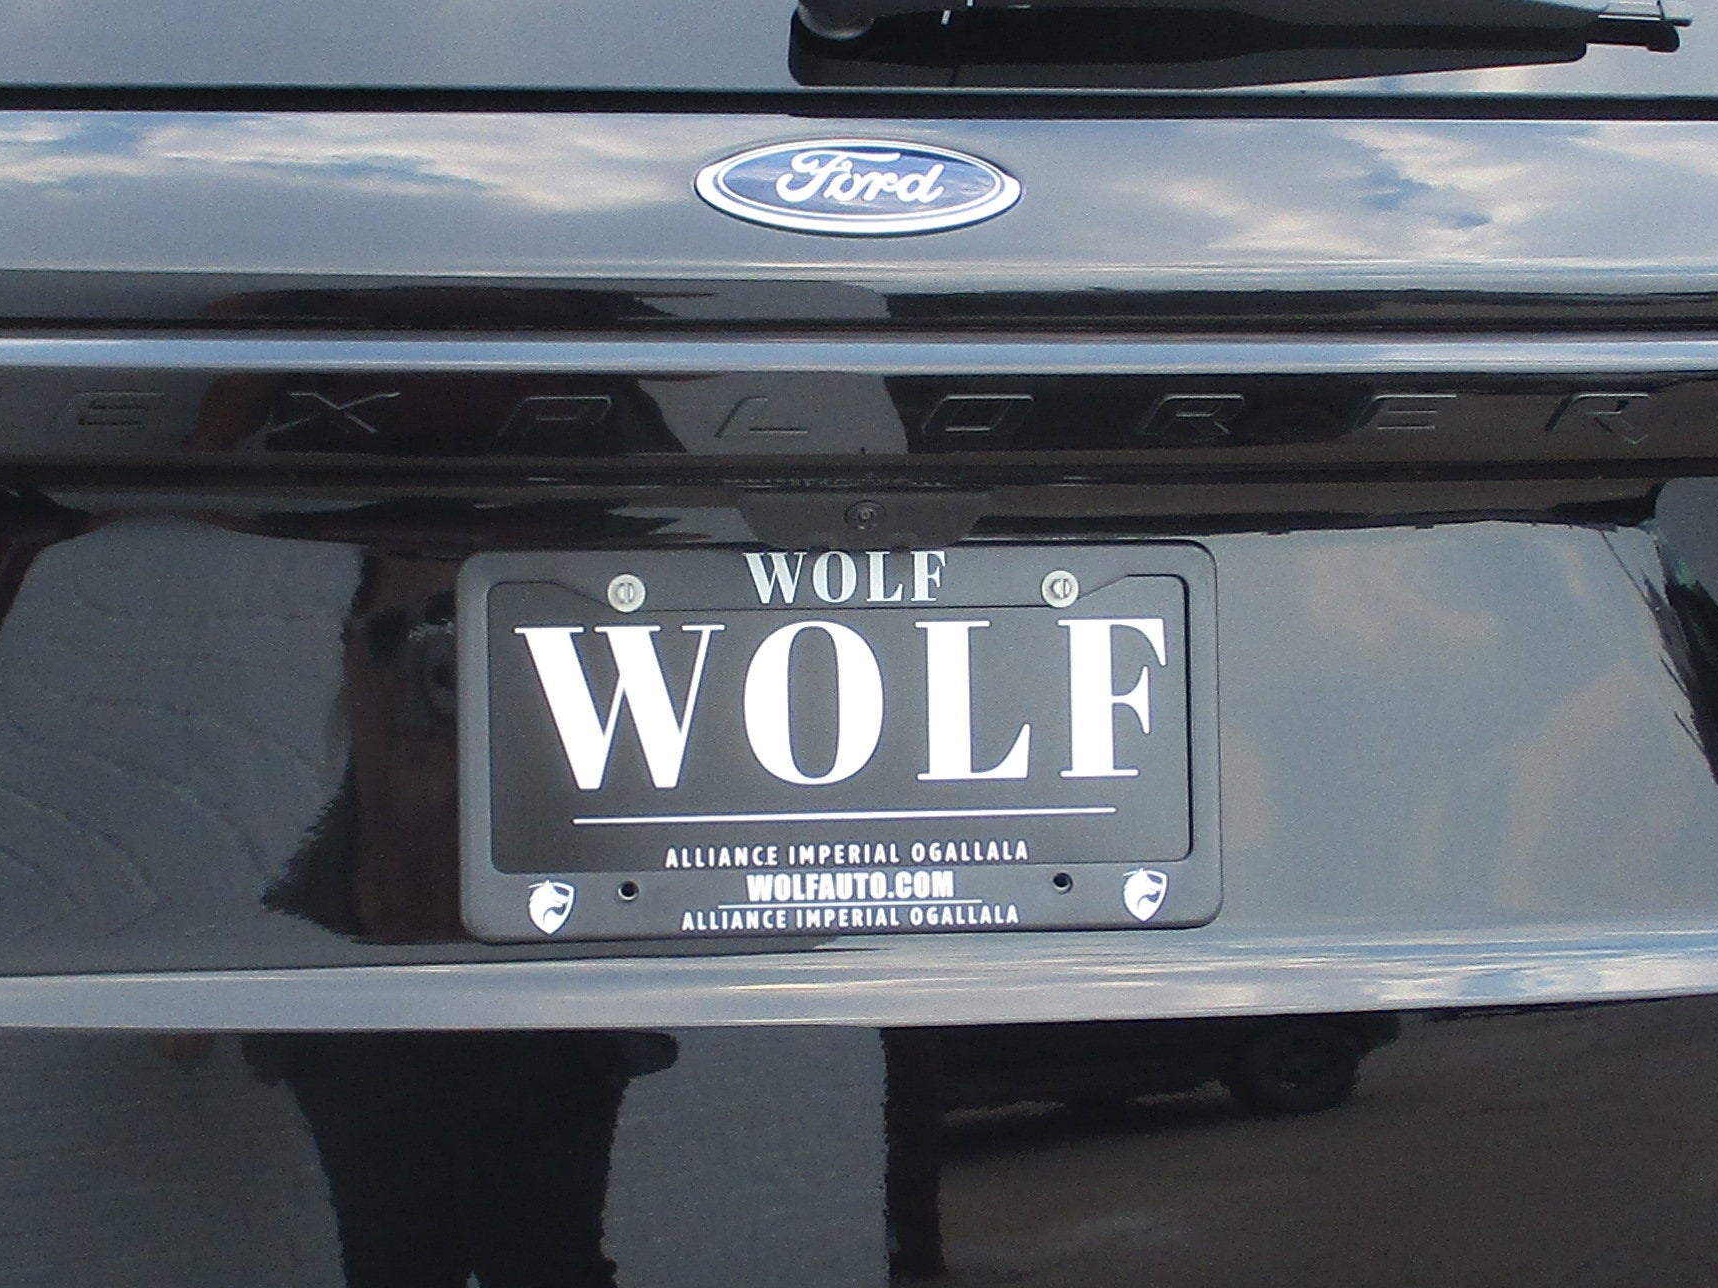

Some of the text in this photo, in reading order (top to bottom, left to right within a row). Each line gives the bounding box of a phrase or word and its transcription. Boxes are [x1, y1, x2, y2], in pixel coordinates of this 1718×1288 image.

[775, 150, 945, 203] Ford
[68, 390, 1650, 441] EXPLORER
[743, 550, 947, 605] WOLF
[514, 618, 1169, 790] WOLF
[665, 839, 1028, 869] ALLIANCE IMPERIAL OGALLALA
[746, 870, 955, 902] WOLFAUTO.COM
[682, 904, 1019, 931] ALLIANCE IMPERIAL OGALLALA
